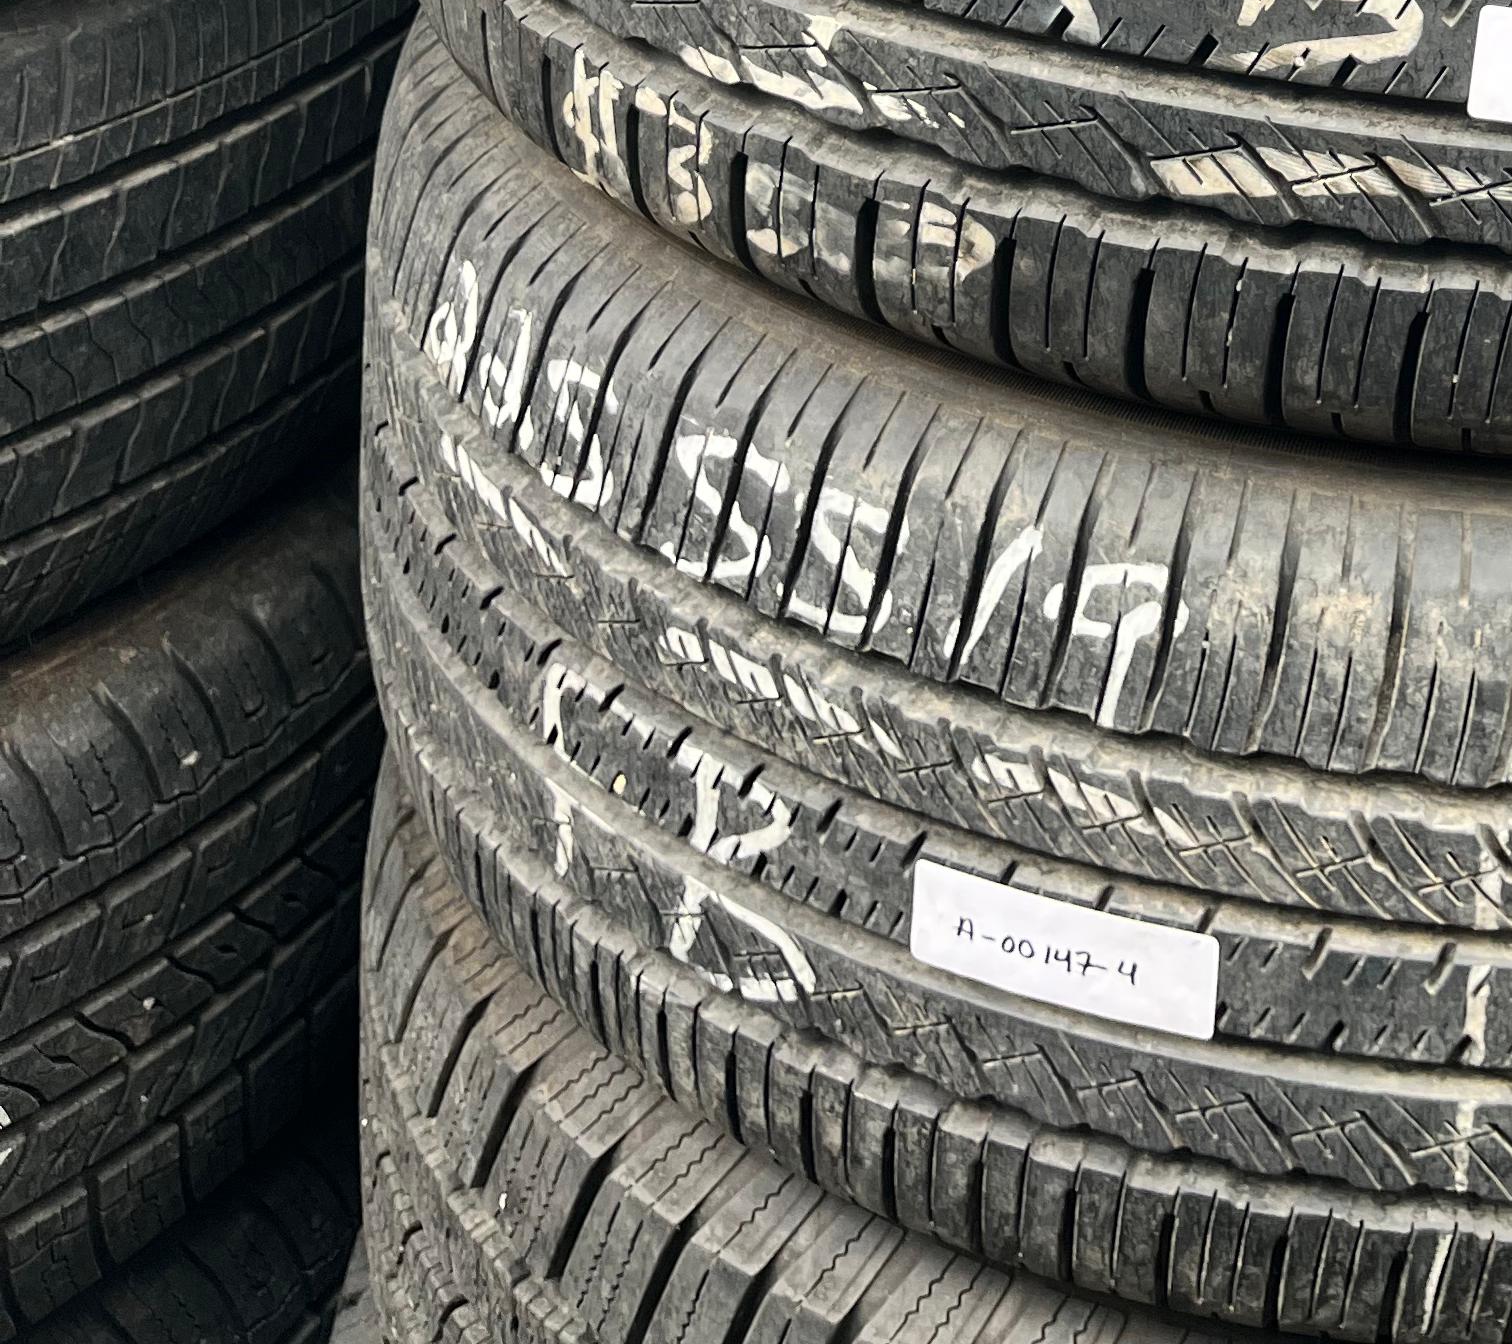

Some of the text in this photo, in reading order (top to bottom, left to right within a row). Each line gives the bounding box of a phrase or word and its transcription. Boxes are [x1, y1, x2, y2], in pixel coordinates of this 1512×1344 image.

[428, 259, 1189, 730] 225 55 19
[954, 916, 1137, 985] A-00147-4
